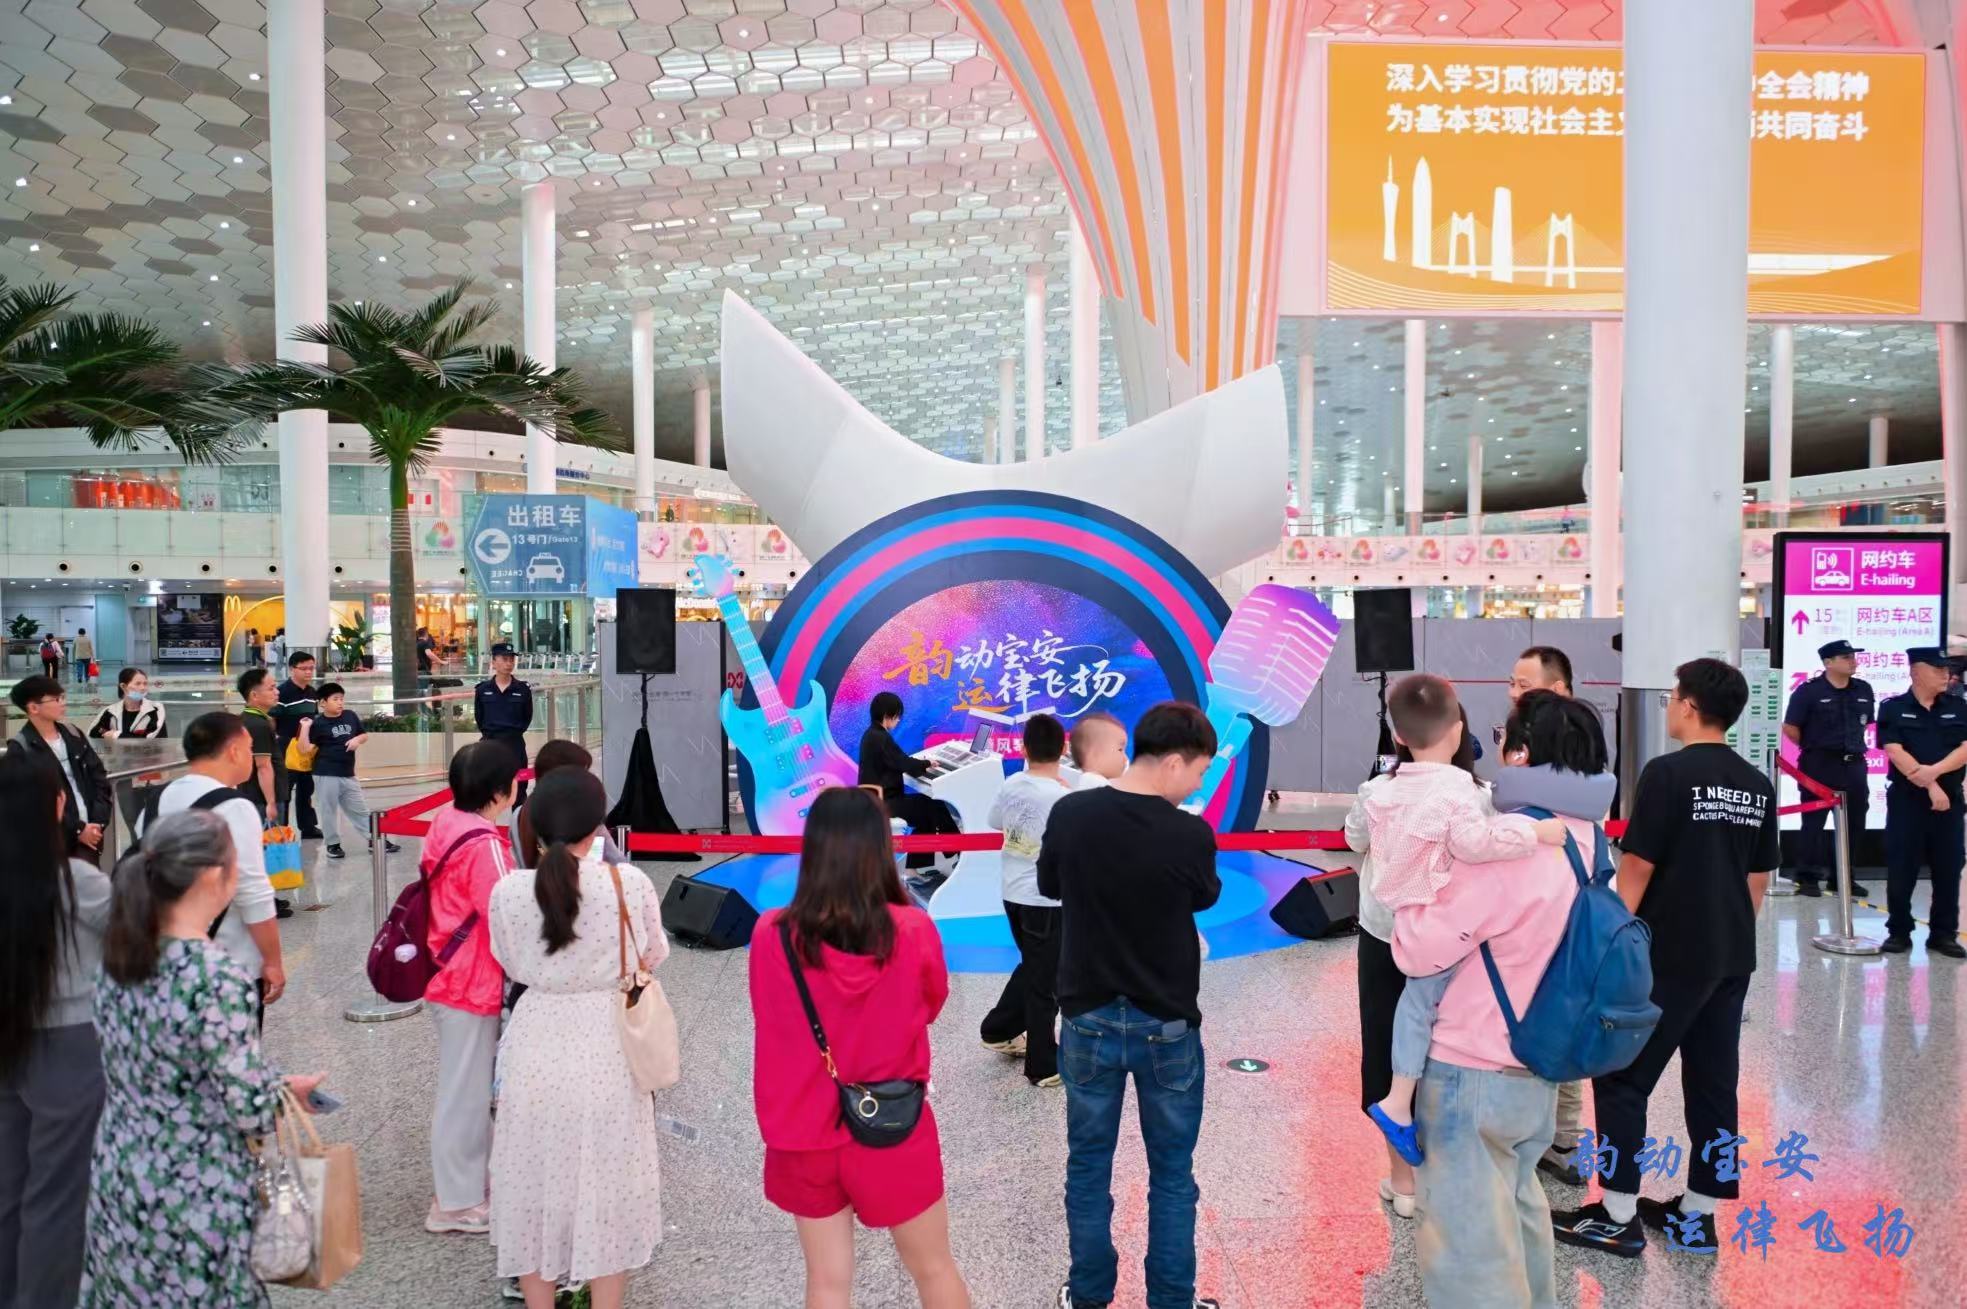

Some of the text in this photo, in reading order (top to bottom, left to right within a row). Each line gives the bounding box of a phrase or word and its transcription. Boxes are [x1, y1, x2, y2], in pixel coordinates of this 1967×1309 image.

[1752, 70, 1870, 101] 全会精神
[1750, 111, 1869, 141] 共同奋斗
[507, 504, 582, 528] 出租车
[1861, 550, 1916, 569] 网约车
[1860, 573, 1916, 589] E-hailing
[1815, 608, 1833, 623] 15
[1857, 607, 1933, 623] 网约车A区
[882, 630, 1108, 686] 韵动宝安
[1855, 652, 1905, 668] 网约车
[951, 659, 1127, 718] 运律飞扬
[1864, 754, 1885, 768] axi
[1691, 786, 1702, 800] I
[1755, 794, 1768, 808] IT
